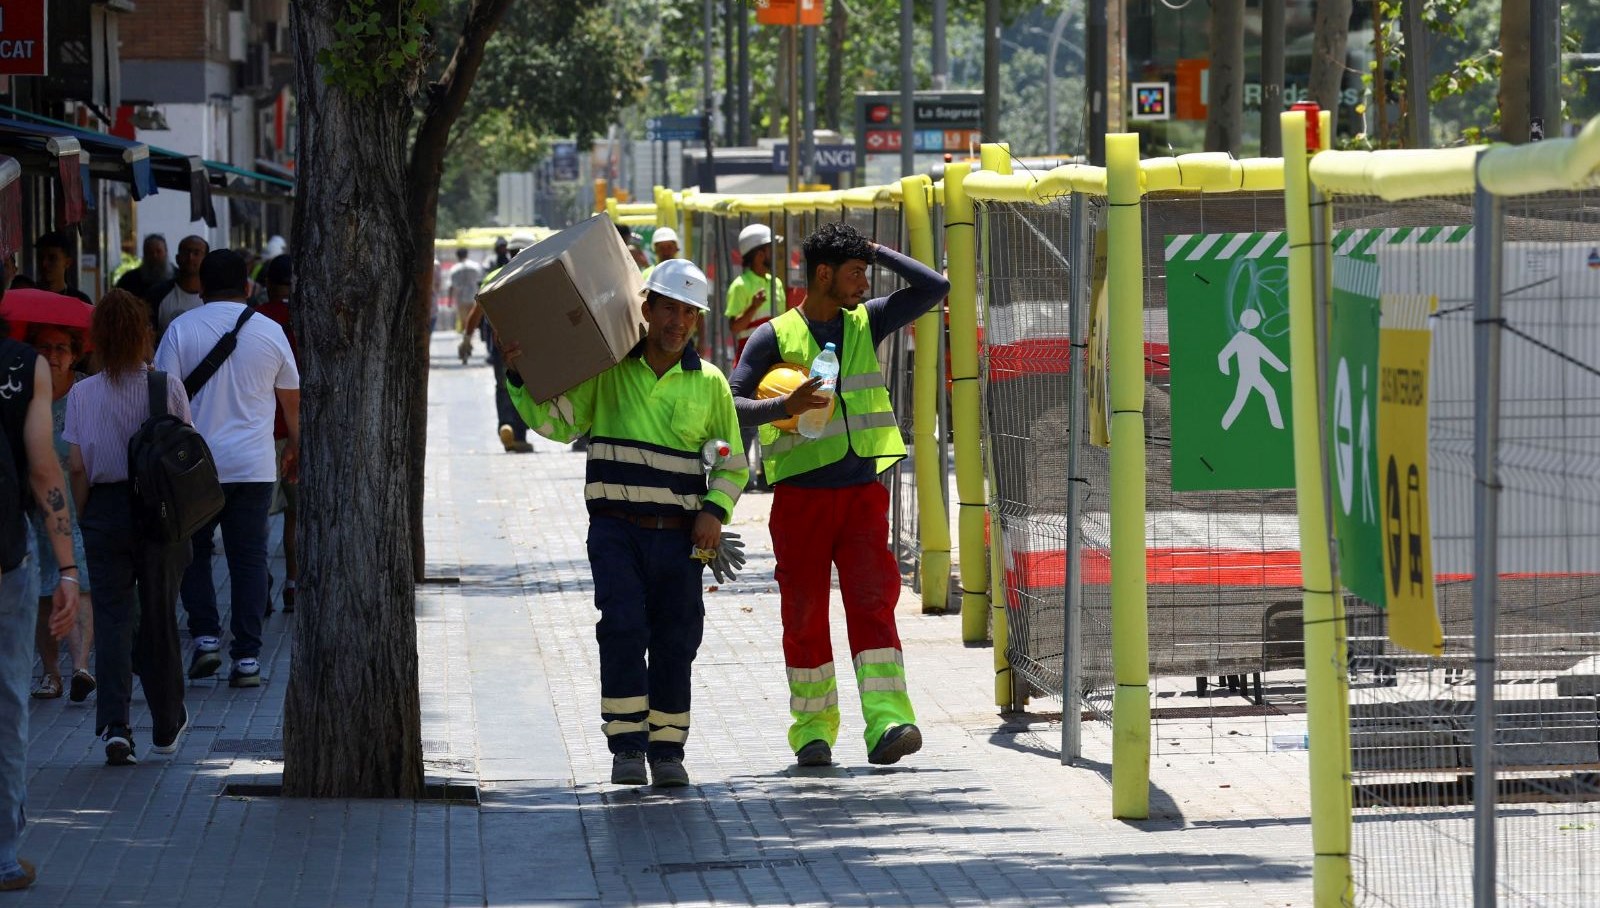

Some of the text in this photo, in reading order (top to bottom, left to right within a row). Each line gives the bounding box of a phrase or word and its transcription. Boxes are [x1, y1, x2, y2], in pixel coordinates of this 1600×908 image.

[0, 40, 35, 58] CAT
[918, 106, 981, 120] La Sagrera
